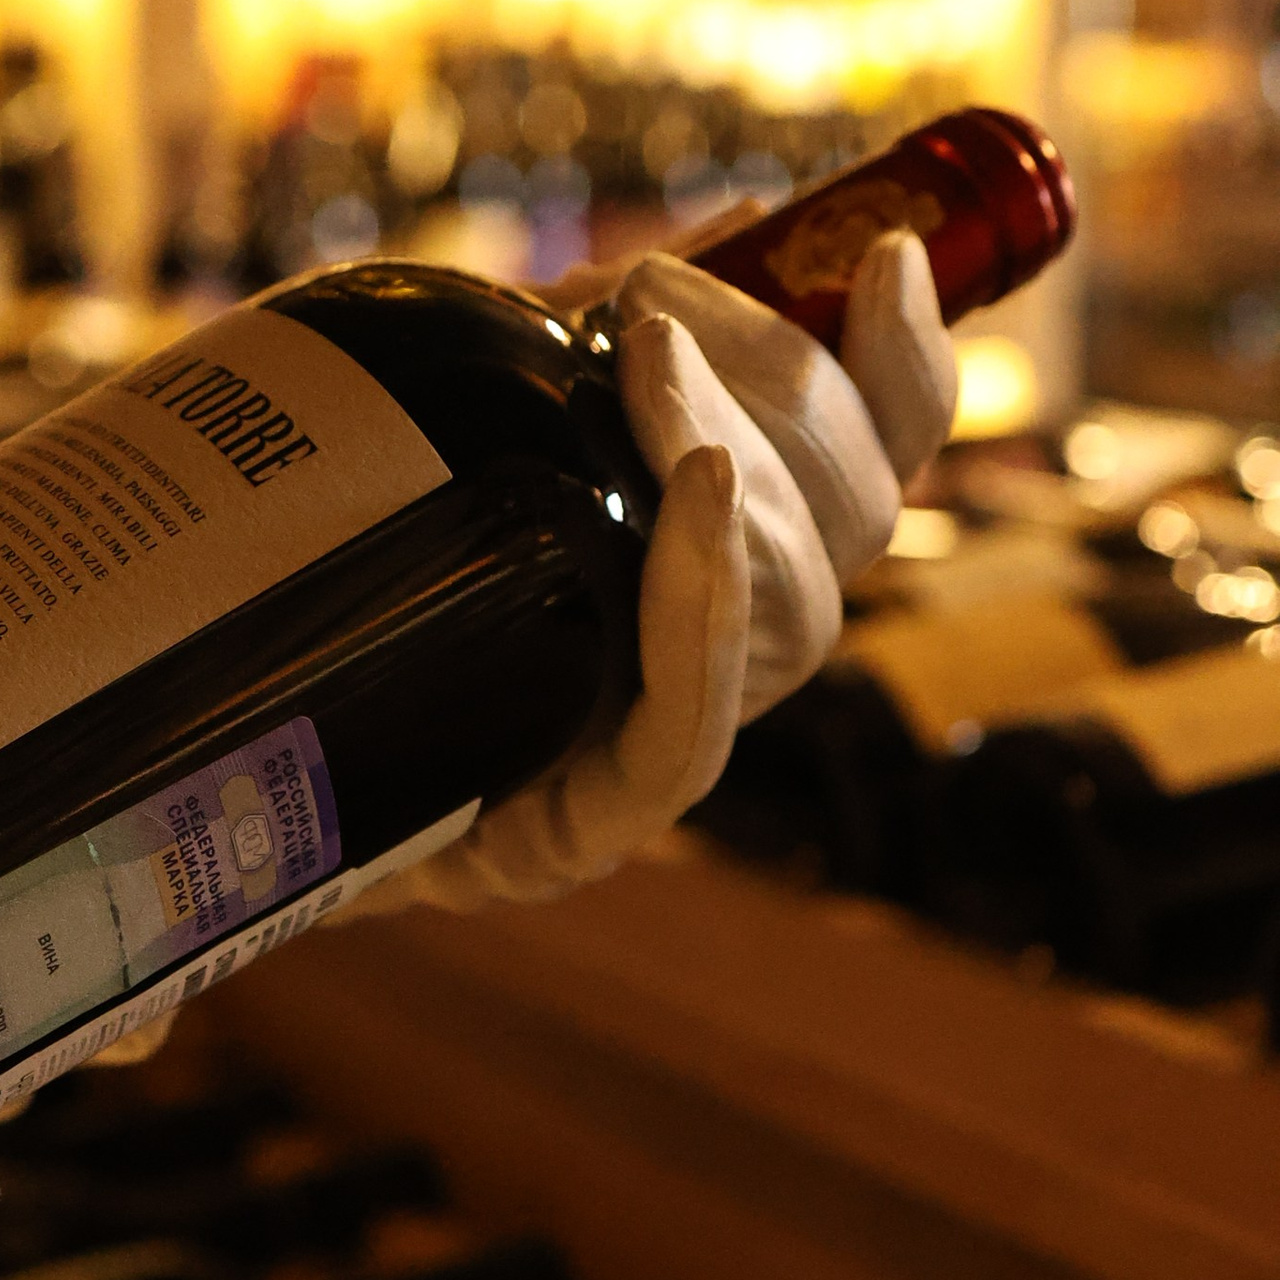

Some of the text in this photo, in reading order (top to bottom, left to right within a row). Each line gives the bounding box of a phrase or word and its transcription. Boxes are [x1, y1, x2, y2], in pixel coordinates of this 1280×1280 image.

[162, 365, 319, 488] TORRE
[99, 491, 159, 553] MIRABILI
[124, 480, 183, 539] PAESAGGI
[141, 456, 207, 524] IDENTITARI
[39, 547, 83, 595] DELLA
[61, 530, 110, 582] GRAZIE
[91, 523, 132, 567] CLIMA
[262, 757, 301, 879] ФЕДЕРАЦИЯ
[277, 747, 315, 872] РОССИЙСКАЯ
[162, 850, 189, 917] МАРКА
[167, 803, 210, 935] СПЕЦИАЛЬНАЯ
[184, 795, 226, 926] ФЕДЕРАЛЬНАЯ
[37, 933, 61, 975] ВИНА
